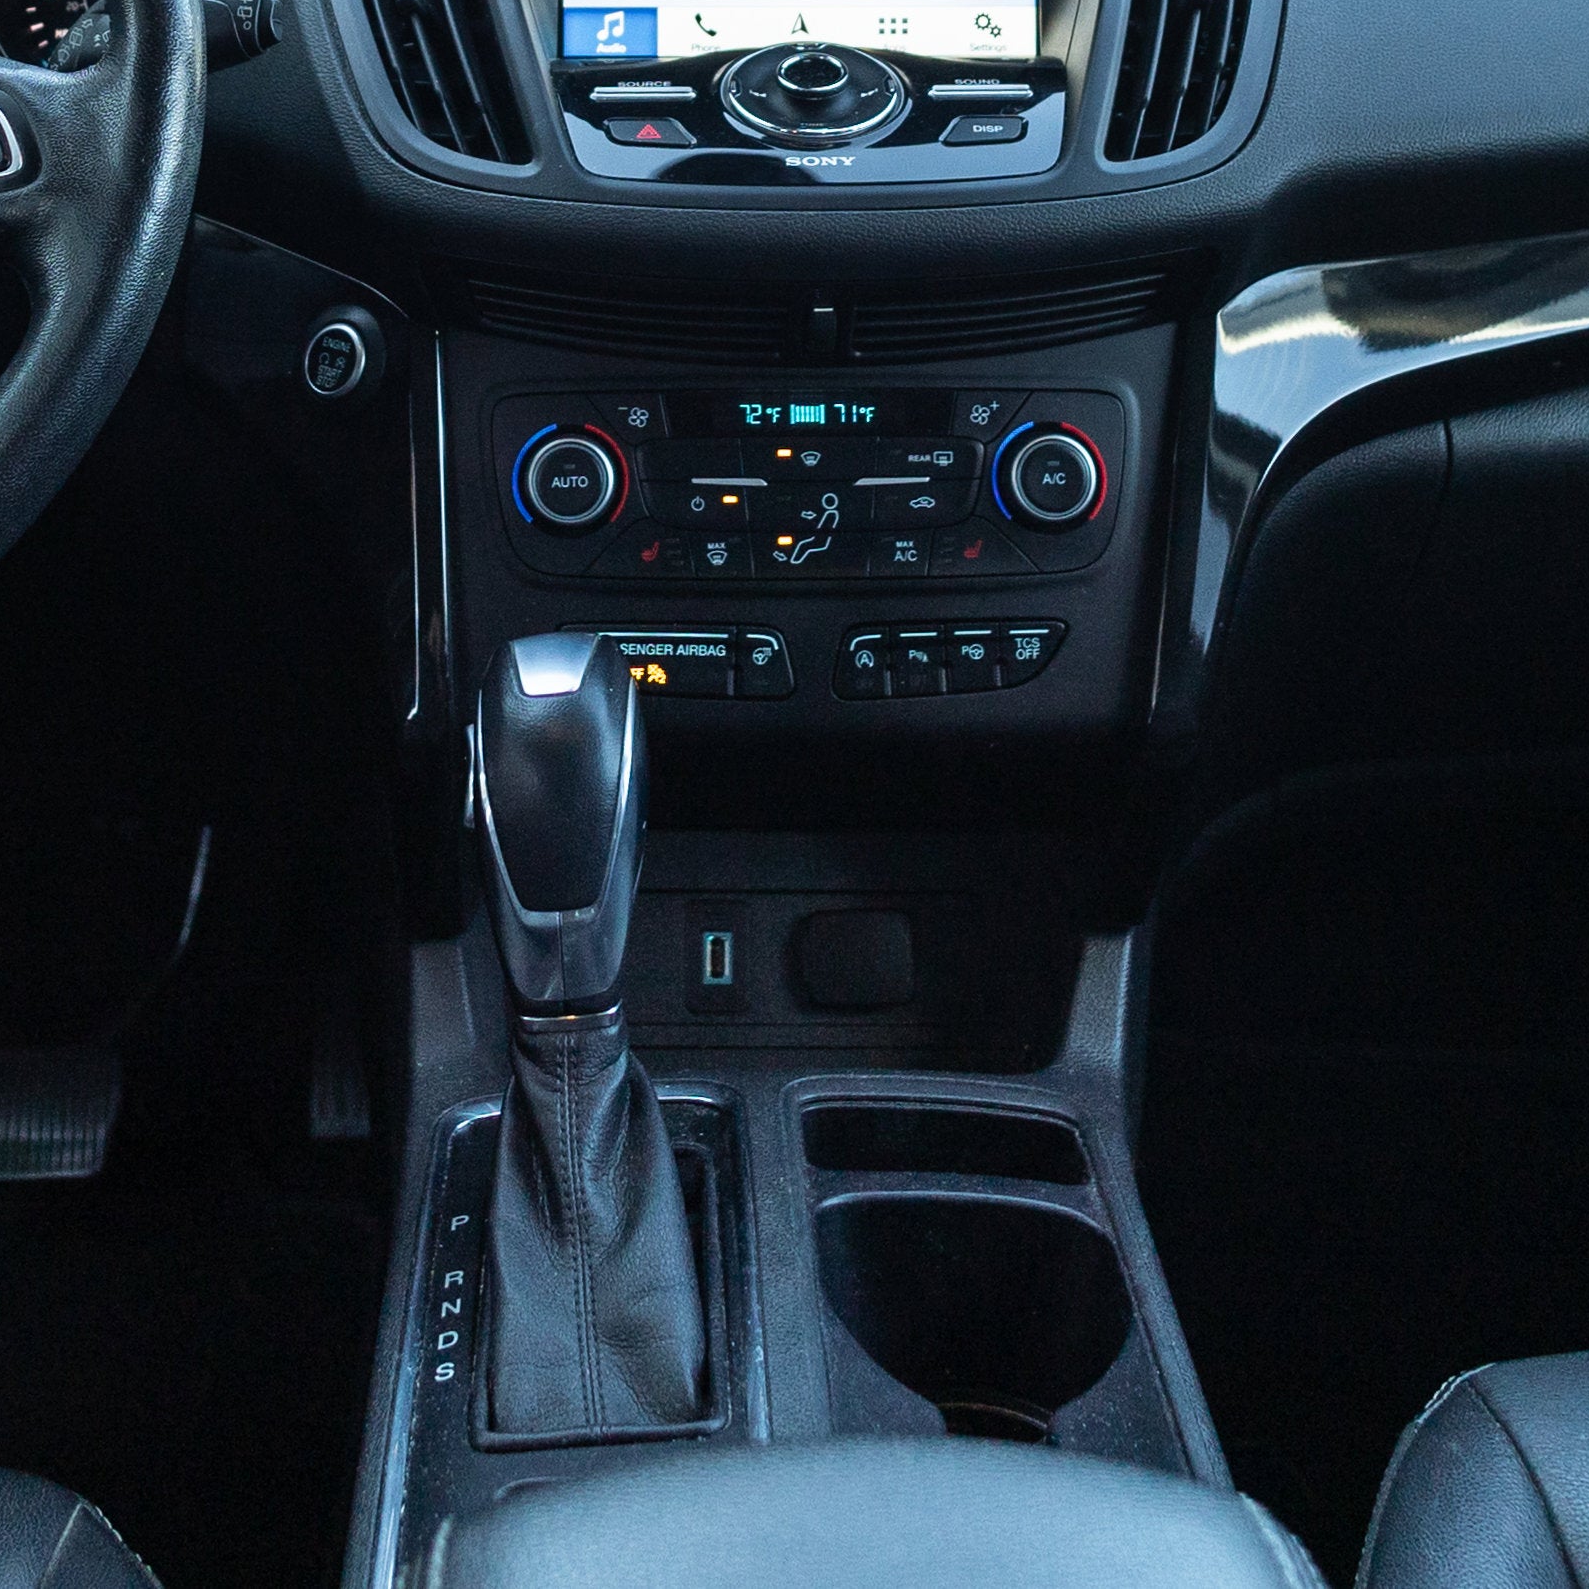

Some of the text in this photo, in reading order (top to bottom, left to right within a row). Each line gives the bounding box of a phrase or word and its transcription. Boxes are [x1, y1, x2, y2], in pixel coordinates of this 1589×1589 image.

[596, 42, 627, 54] Audio
[691, 43, 721, 52] Phone
[970, 43, 1007, 53] Settings
[617, 80, 672, 88] SOURCE
[972, 124, 1004, 133] DISP
[785, 156, 856, 167] SONY
[907, 454, 931, 462] REAR
[551, 475, 589, 488] AUTO
[1042, 472, 1067, 485] A/C
[707, 542, 726, 550] MAX
[896, 540, 914, 548] MAX
[894, 550, 918, 562] A/C
[1015, 637, 1040, 648] TCS
[619, 643, 727, 657] SENGER AIRBAG
[1015, 649, 1040, 660] OFF
[629, 667, 646, 680] FF
[451, 1214, 470, 1232] P
[444, 1270, 464, 1289] R
[441, 1297, 462, 1319] N
[437, 1330, 459, 1350] D
[434, 1362, 455, 1382] S
